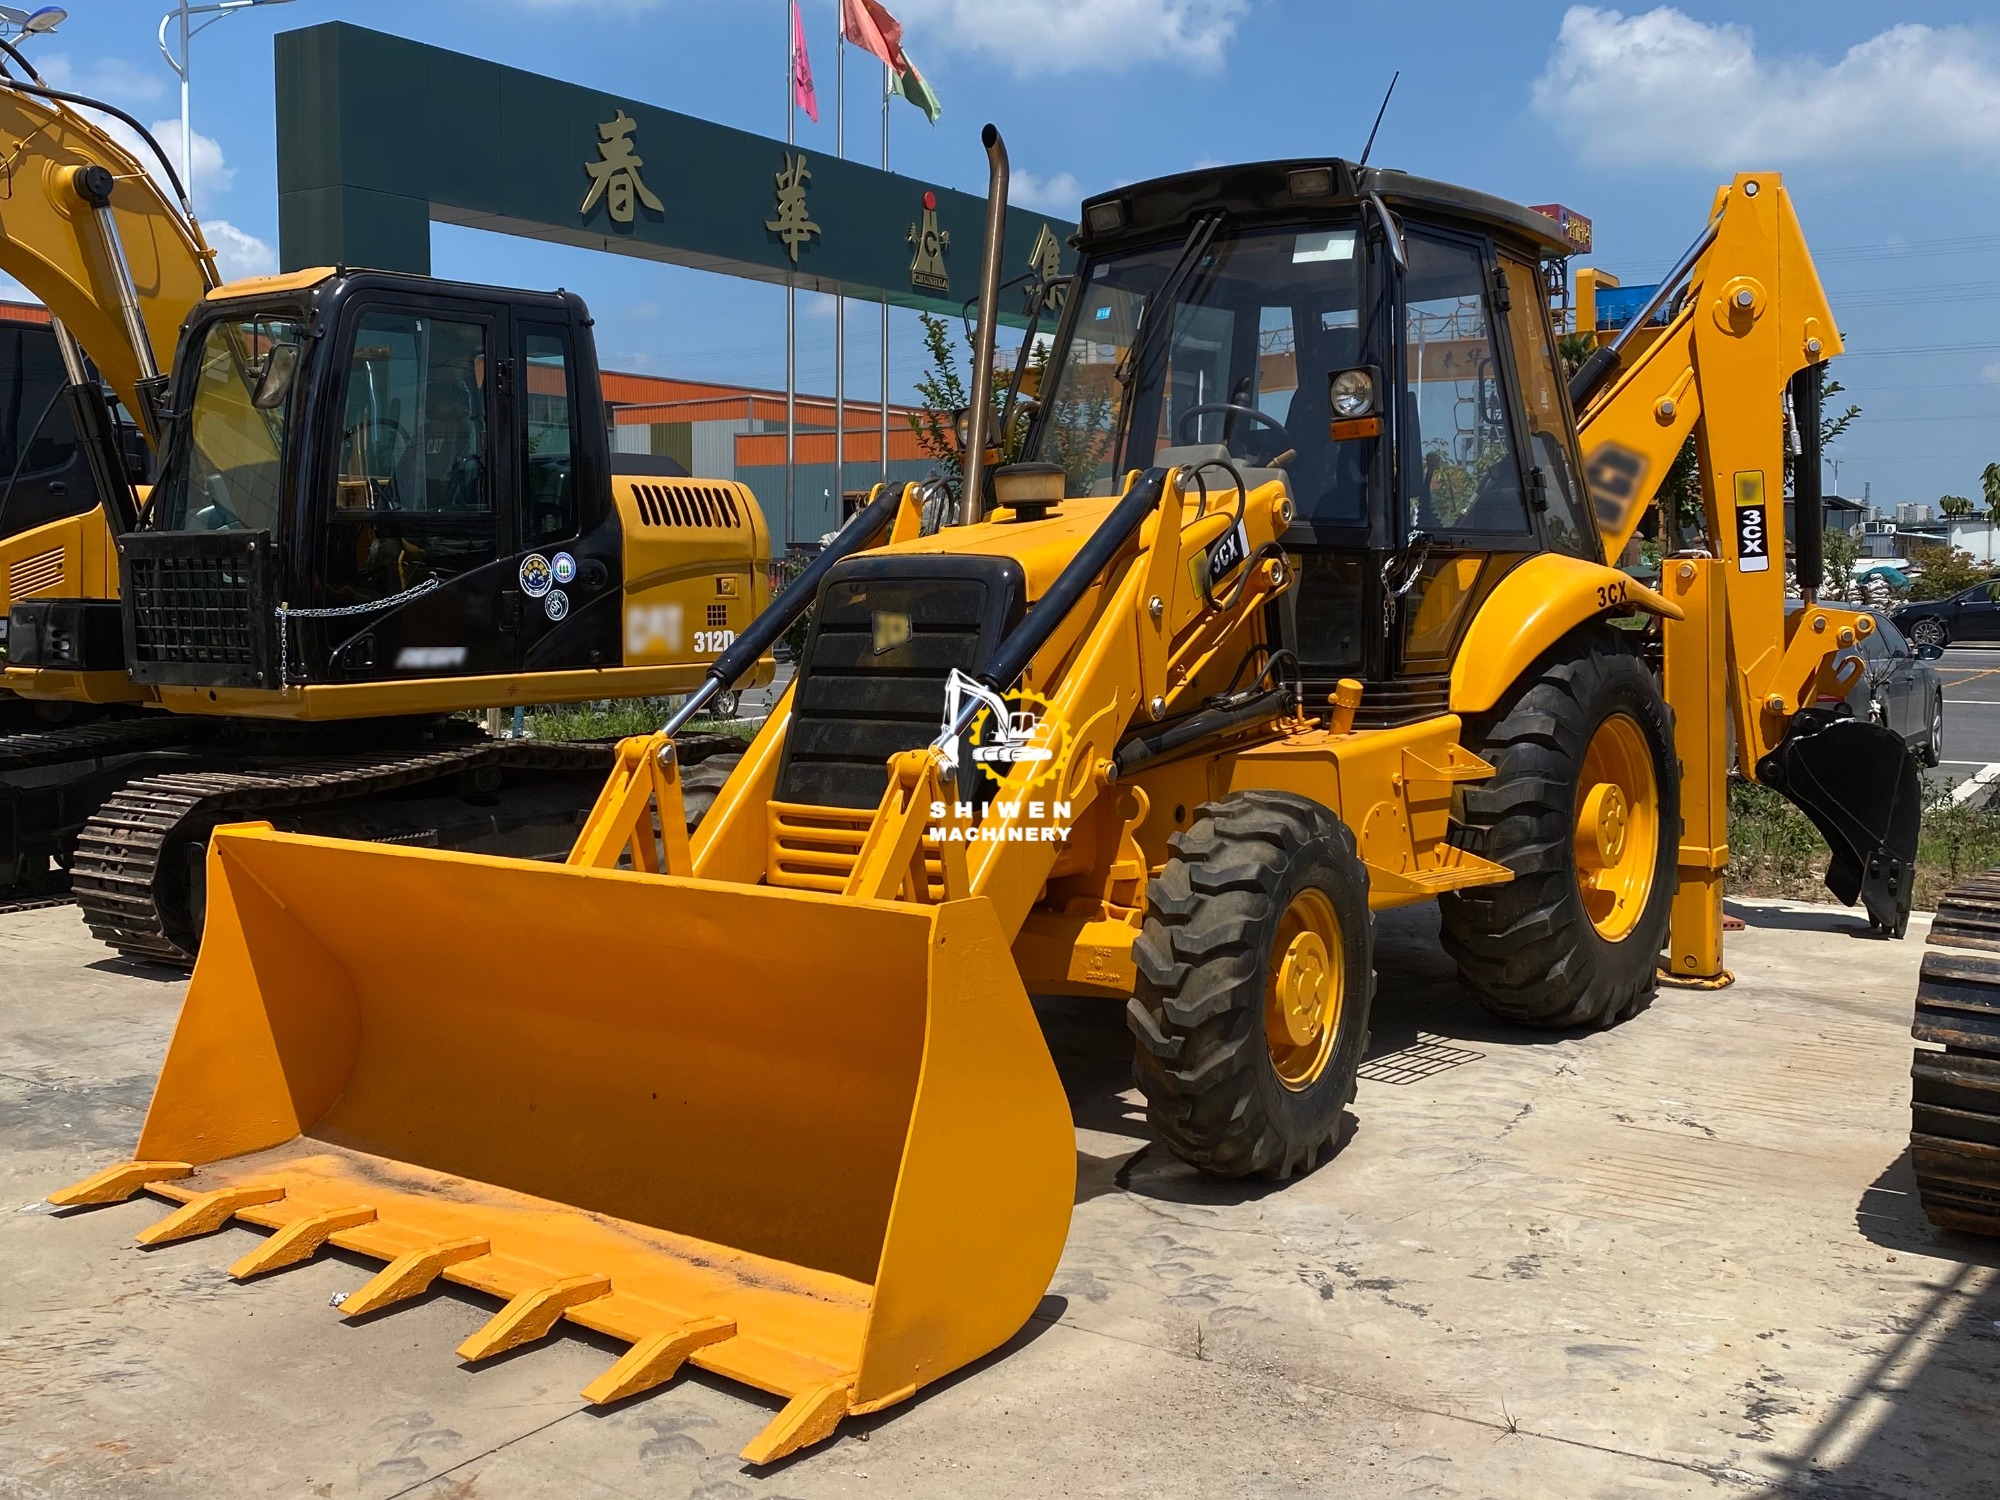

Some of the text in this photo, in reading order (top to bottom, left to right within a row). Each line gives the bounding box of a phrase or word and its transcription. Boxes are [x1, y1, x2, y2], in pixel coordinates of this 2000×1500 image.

[913, 273, 949, 289] CHUNHUA
[1742, 509, 1764, 554] 3CX
[1597, 580, 1628, 608] 3CX
[693, 629, 735, 653] 312D
